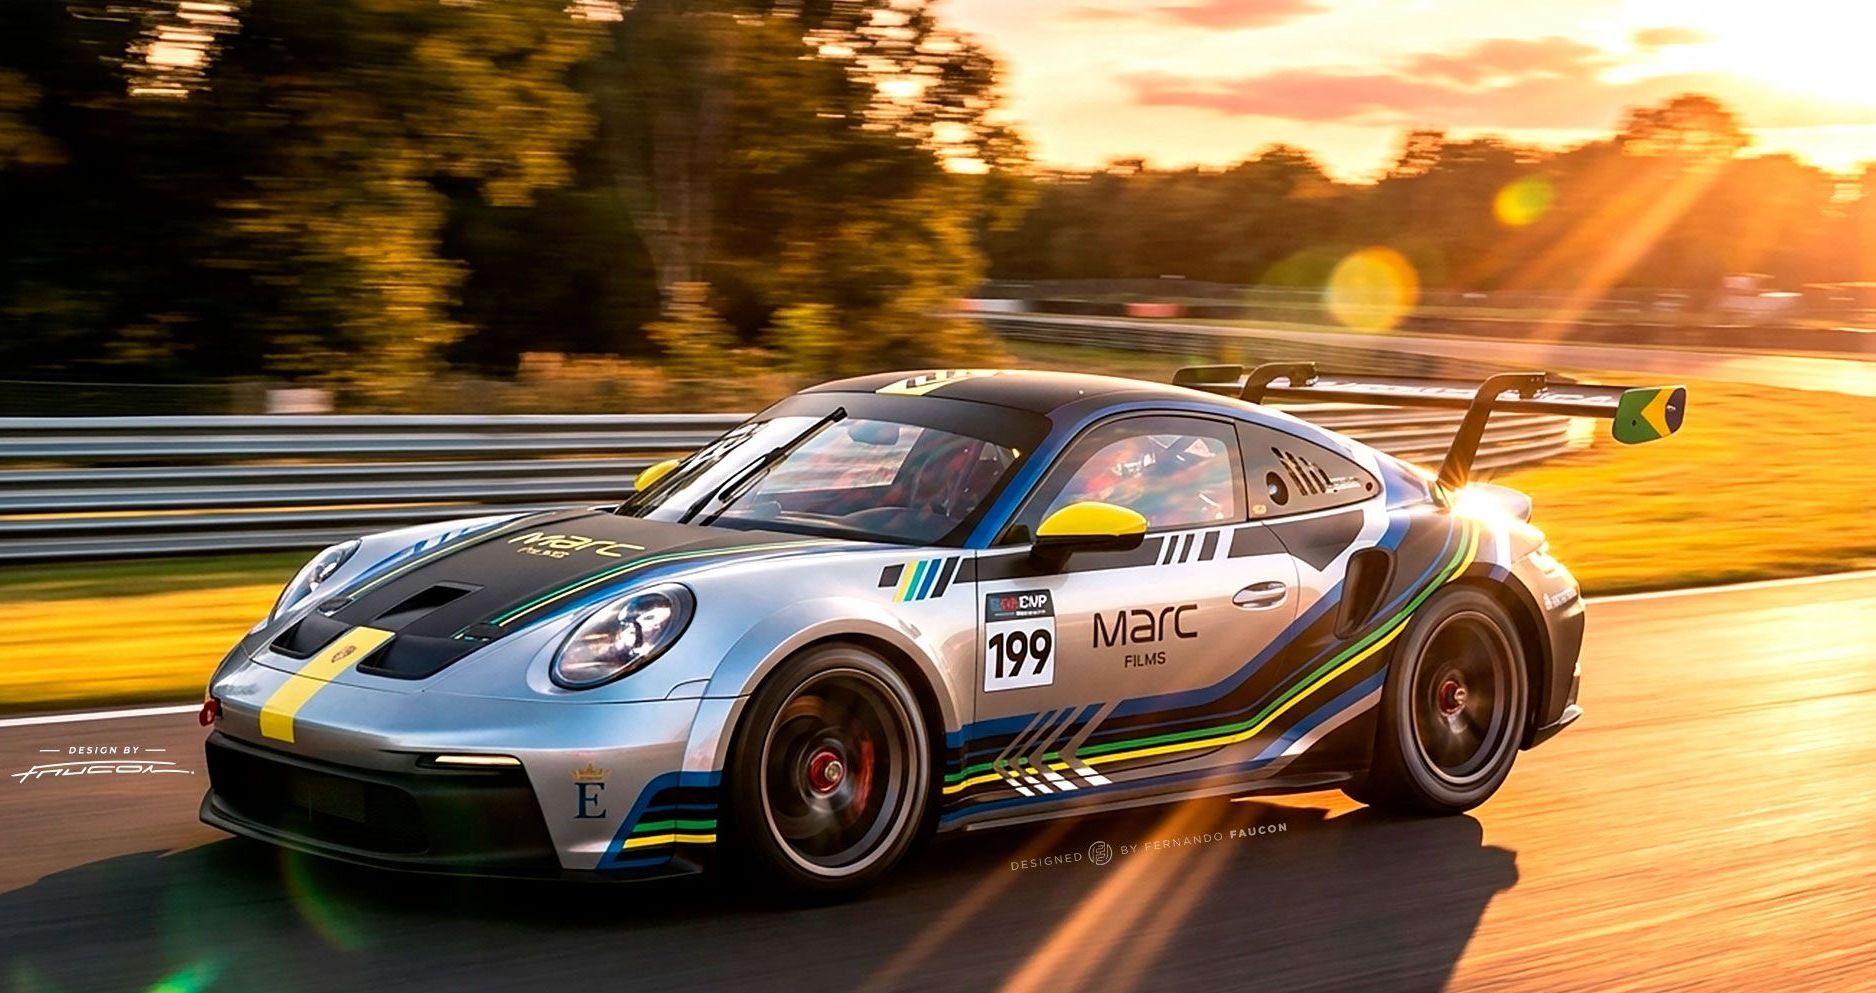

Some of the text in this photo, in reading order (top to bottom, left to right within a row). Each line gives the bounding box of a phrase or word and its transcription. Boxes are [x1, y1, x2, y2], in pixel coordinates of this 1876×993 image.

[1092, 603, 1198, 649] Marc
[988, 628, 1052, 679] 199
[1124, 651, 1167, 669] FILMS
[573, 781, 607, 819] E
